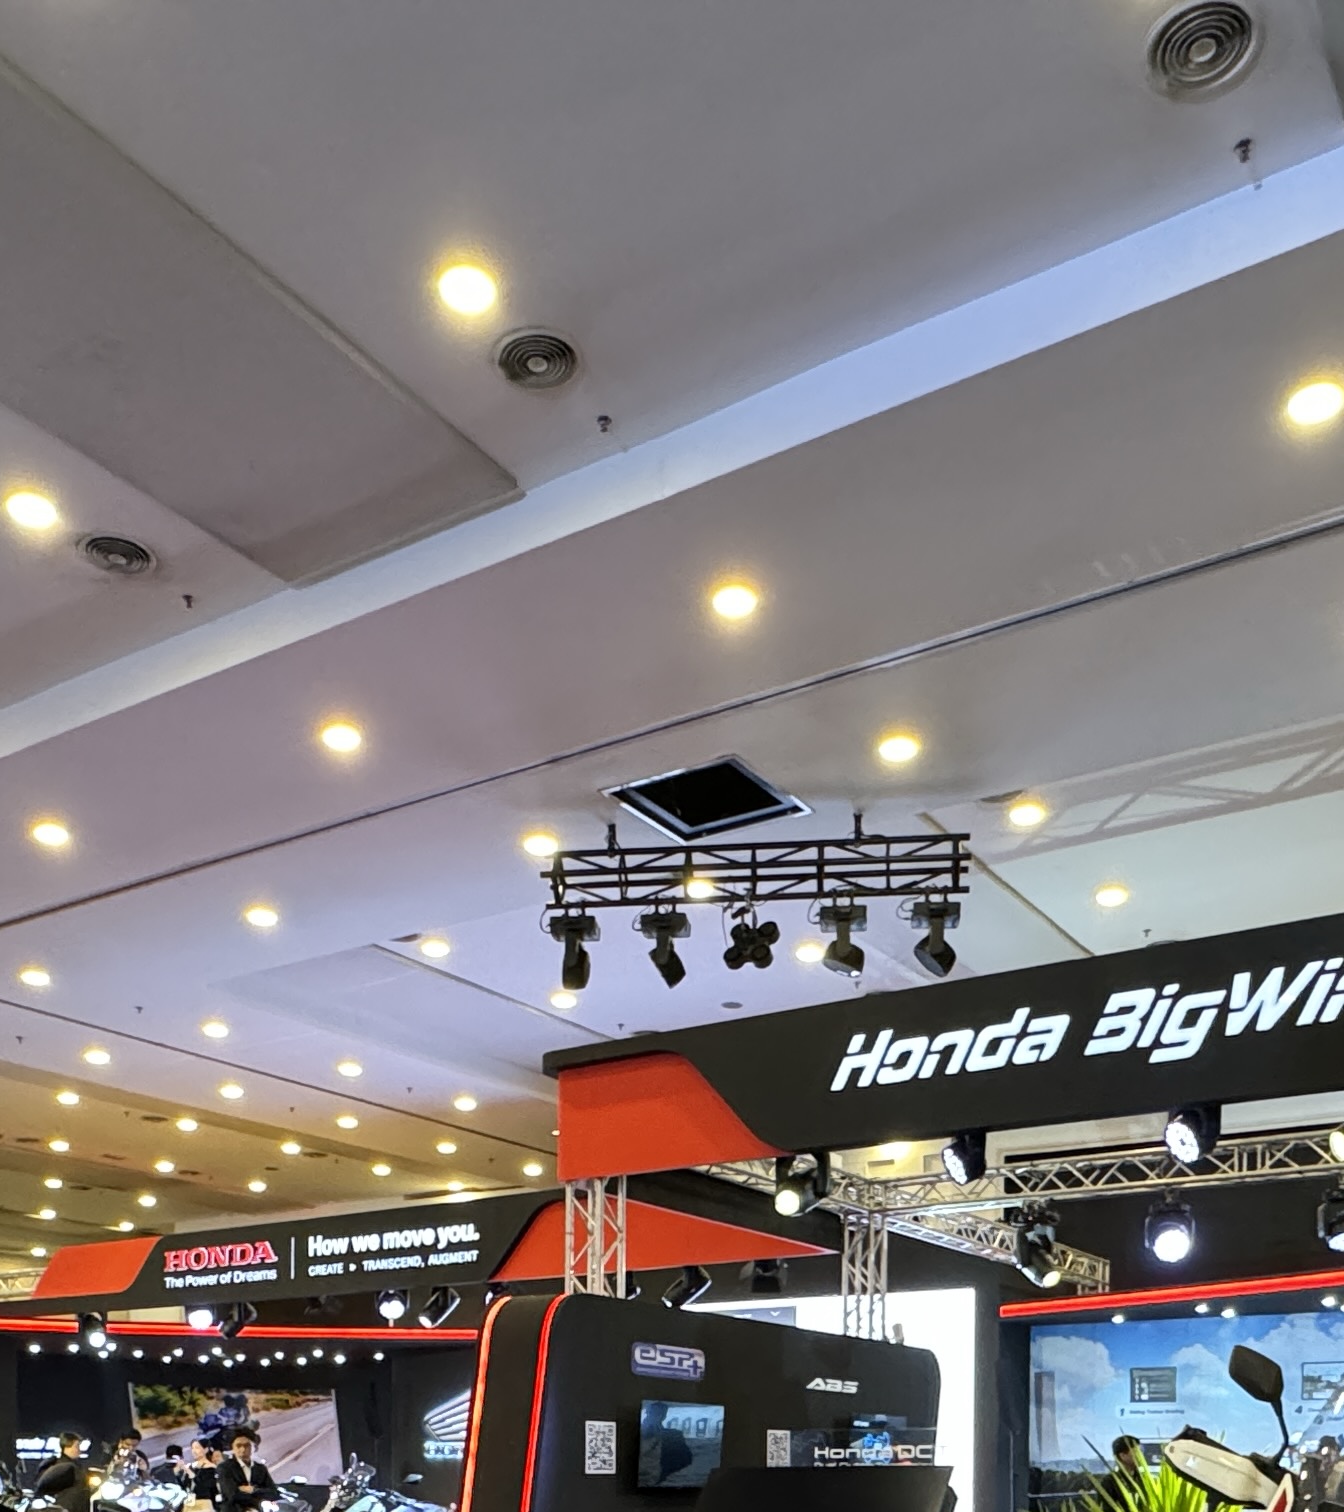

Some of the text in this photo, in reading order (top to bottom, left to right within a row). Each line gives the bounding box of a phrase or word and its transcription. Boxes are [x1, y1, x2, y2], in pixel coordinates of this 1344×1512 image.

[830, 1007, 1070, 1093] Honda
[308, 1223, 480, 1257] How we move you.
[164, 1241, 278, 1272] HONDA
[308, 1250, 479, 1276] CREATE TRANSCEND, AUGMENT
[164, 1269, 277, 1289] The Power of Dreams
[806, 1377, 859, 1394] ABS
